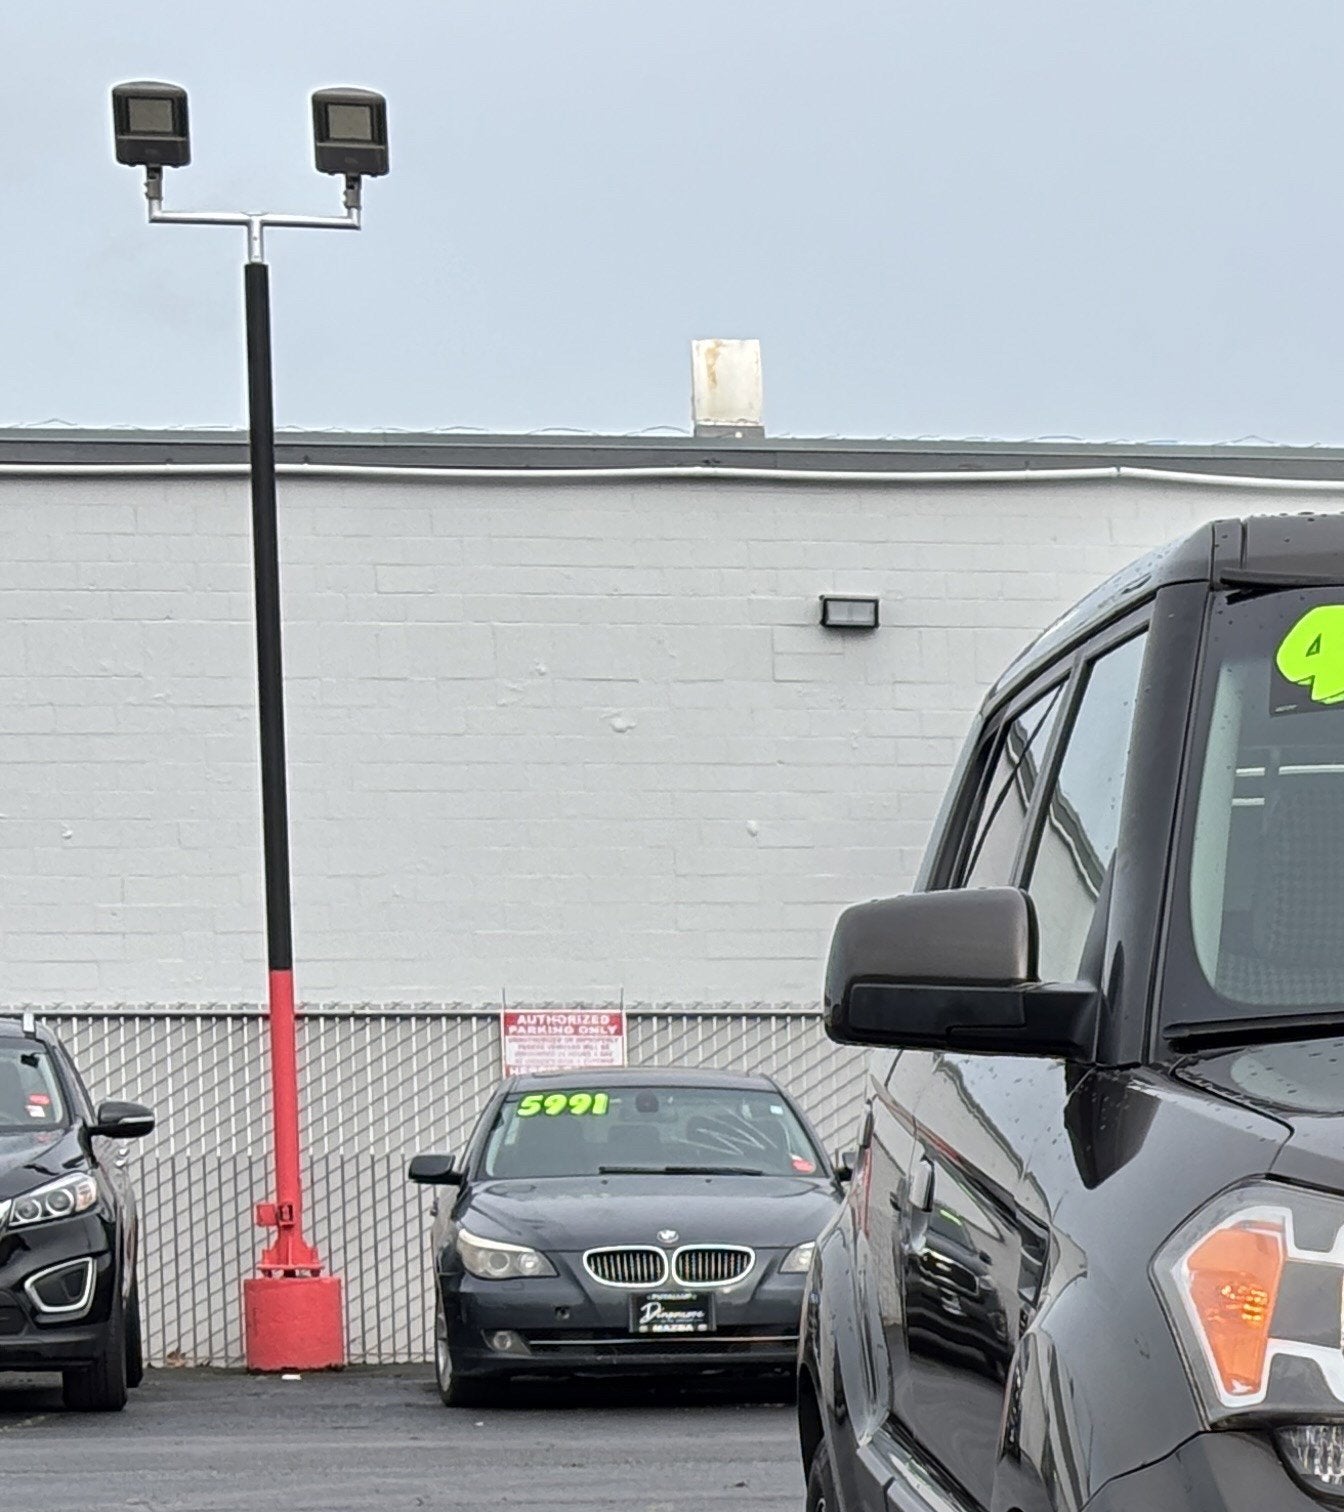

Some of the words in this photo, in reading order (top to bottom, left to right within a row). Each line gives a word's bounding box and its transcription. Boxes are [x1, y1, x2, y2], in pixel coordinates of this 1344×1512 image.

[517, 1014, 610, 1025] AUTHORIZED
[508, 1025, 575, 1034] PARKING
[578, 1025, 618, 1034] ONLY
[517, 1093, 609, 1116] 5991
